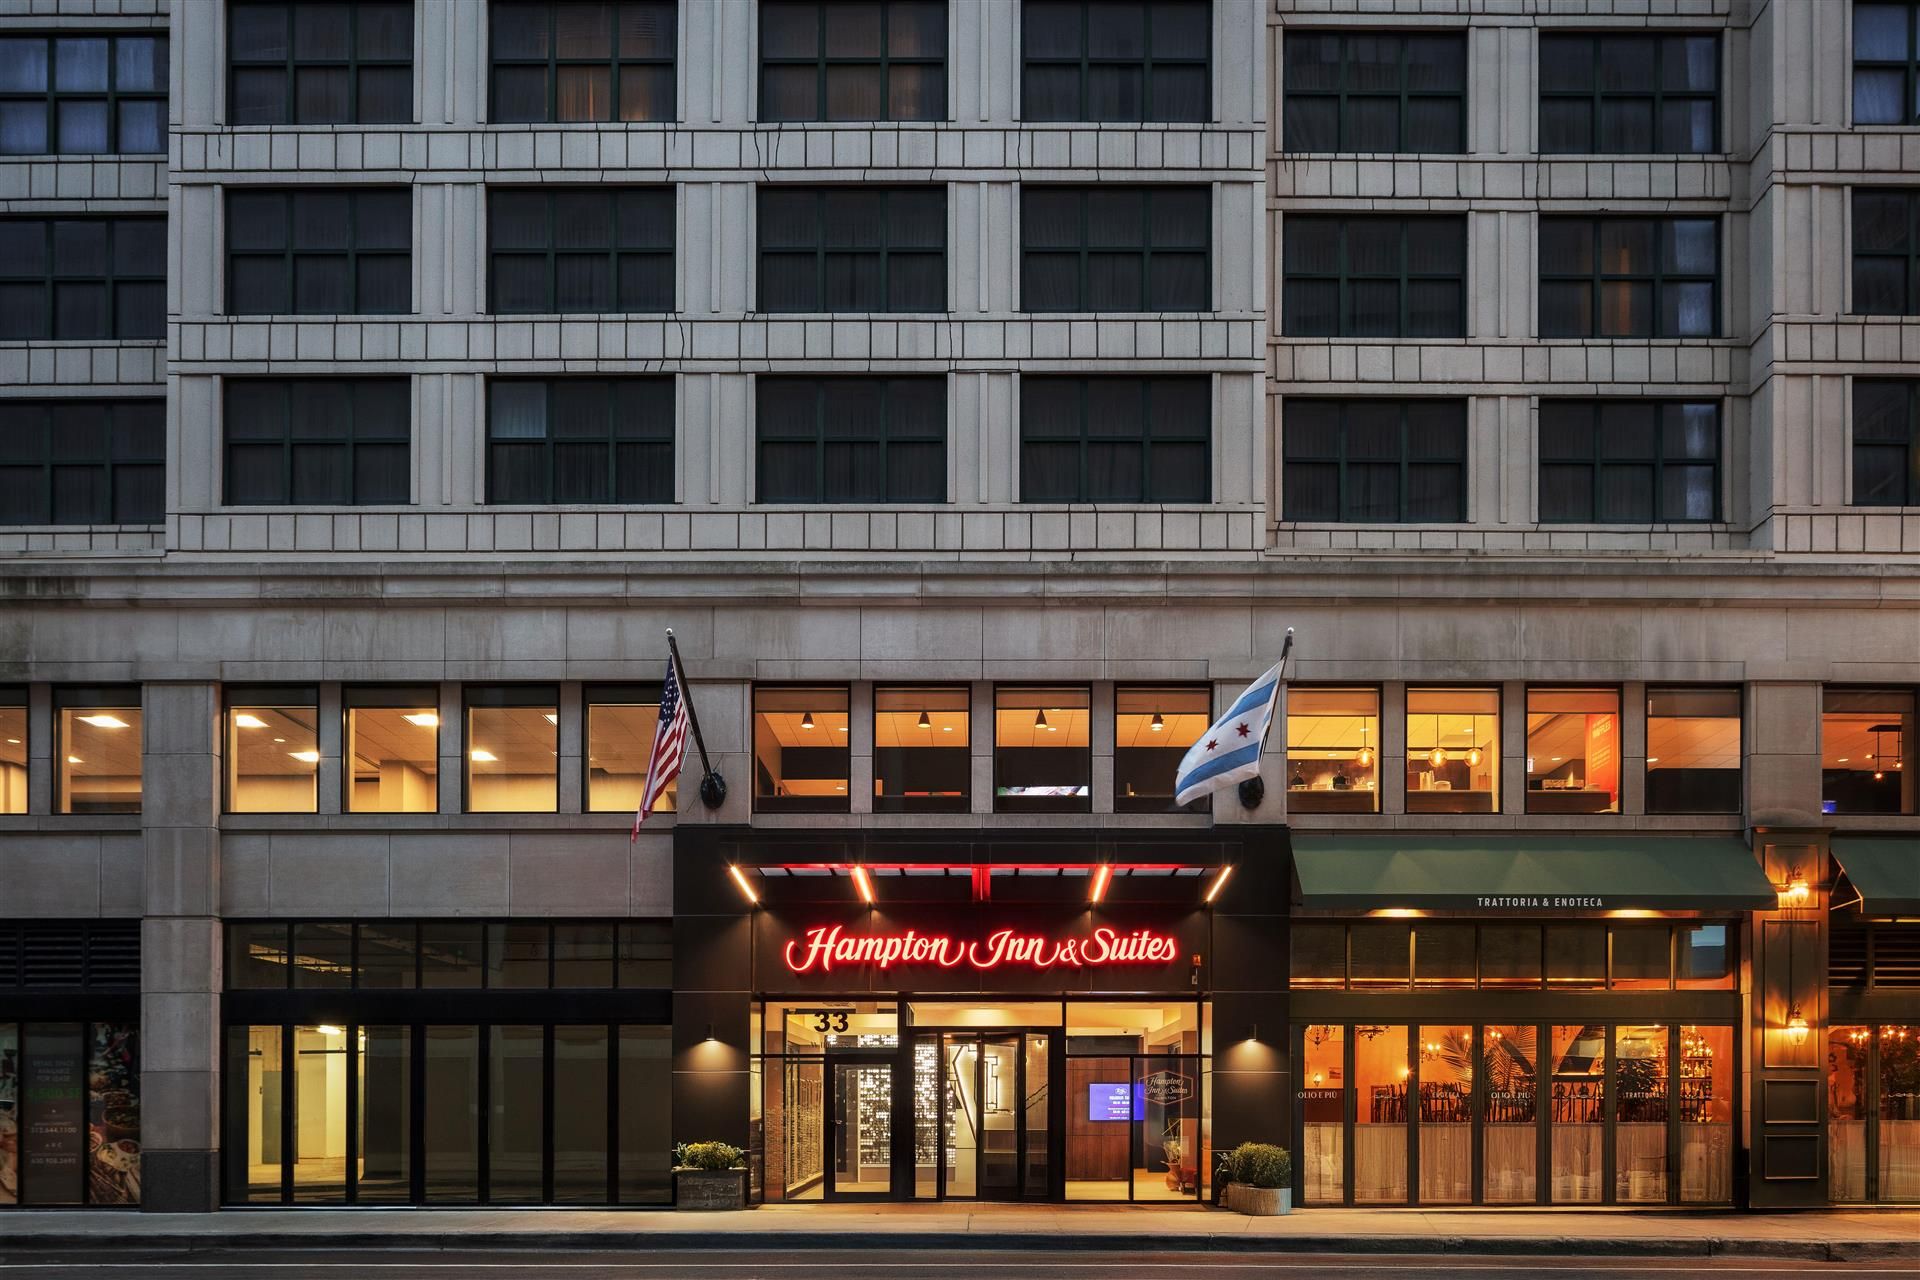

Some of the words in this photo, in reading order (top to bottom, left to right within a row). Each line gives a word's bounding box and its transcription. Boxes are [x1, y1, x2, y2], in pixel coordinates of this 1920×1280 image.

[1477, 897, 1539, 907] TRATTORIA
[1542, 897, 1550, 907] &
[1554, 897, 1603, 907] ENOTECA
[786, 925, 967, 972] Hampton
[970, 929, 1062, 968] Inn
[1059, 938, 1085, 966] &
[1081, 928, 1176, 963] Suites
[814, 1010, 849, 1033] 33
[1146, 1077, 1184, 1086] Hampton
[1297, 1091, 1317, 1099] OLIO
[1318, 1091, 1324, 1099] E
